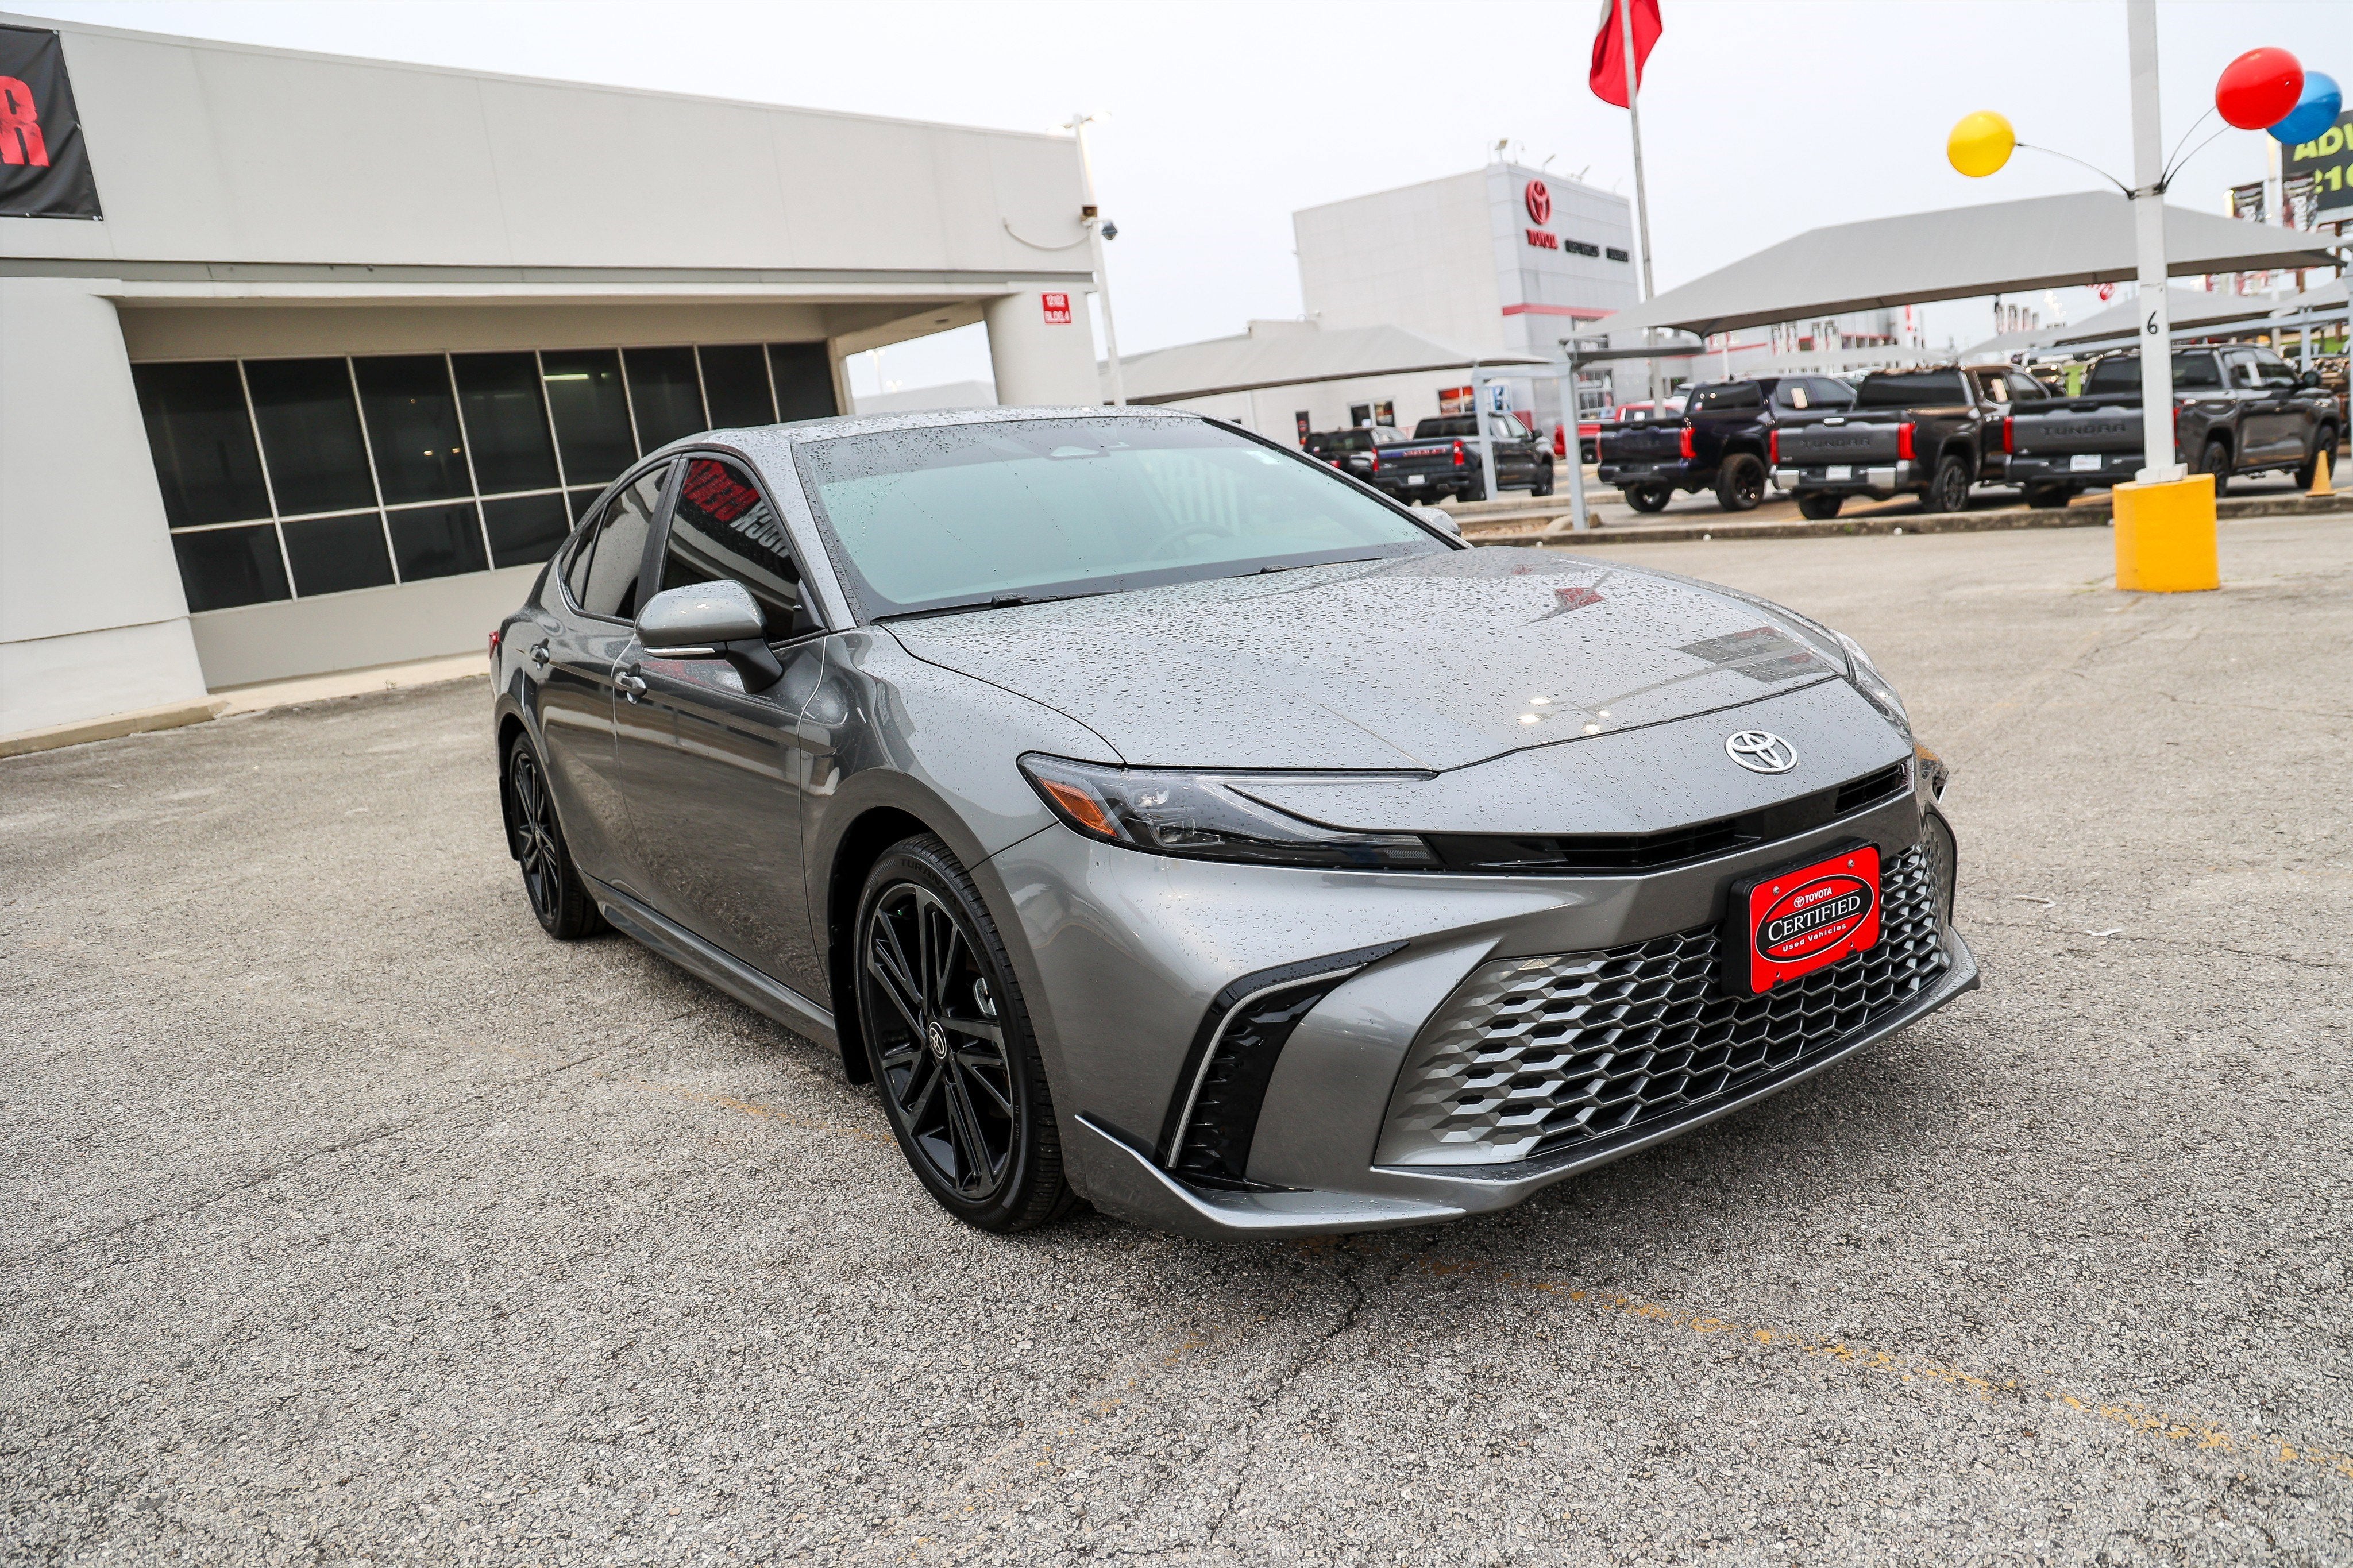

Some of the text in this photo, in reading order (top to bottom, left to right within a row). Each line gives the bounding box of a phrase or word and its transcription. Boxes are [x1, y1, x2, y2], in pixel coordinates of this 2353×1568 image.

[2146, 309, 2158, 335] 6
[900, 858, 958, 906] TURANZA
[1804, 887, 1833, 903] TOYOTA
[1768, 896, 1861, 941] CERTIFIED
[1783, 924, 1846, 952] Used Vehicles
